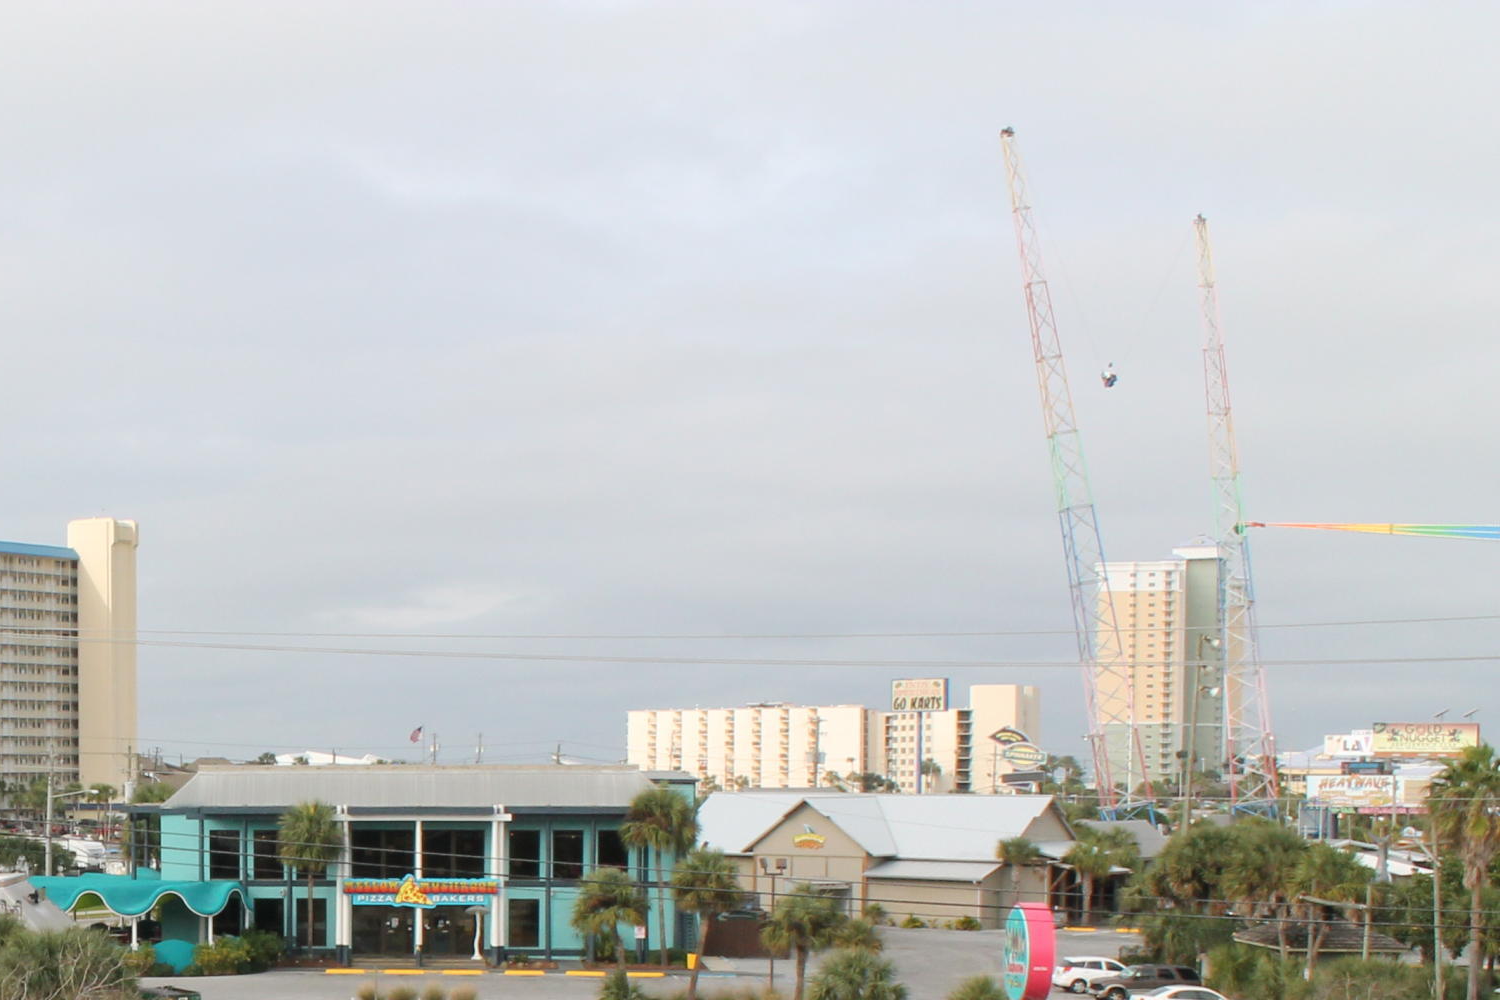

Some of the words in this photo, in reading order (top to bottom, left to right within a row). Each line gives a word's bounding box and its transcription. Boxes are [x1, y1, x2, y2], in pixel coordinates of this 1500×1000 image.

[893, 697, 906, 710] GO
[910, 696, 941, 709] KARTS
[1405, 724, 1442, 734] GOLD
[1400, 734, 1445, 743] NUGGET
